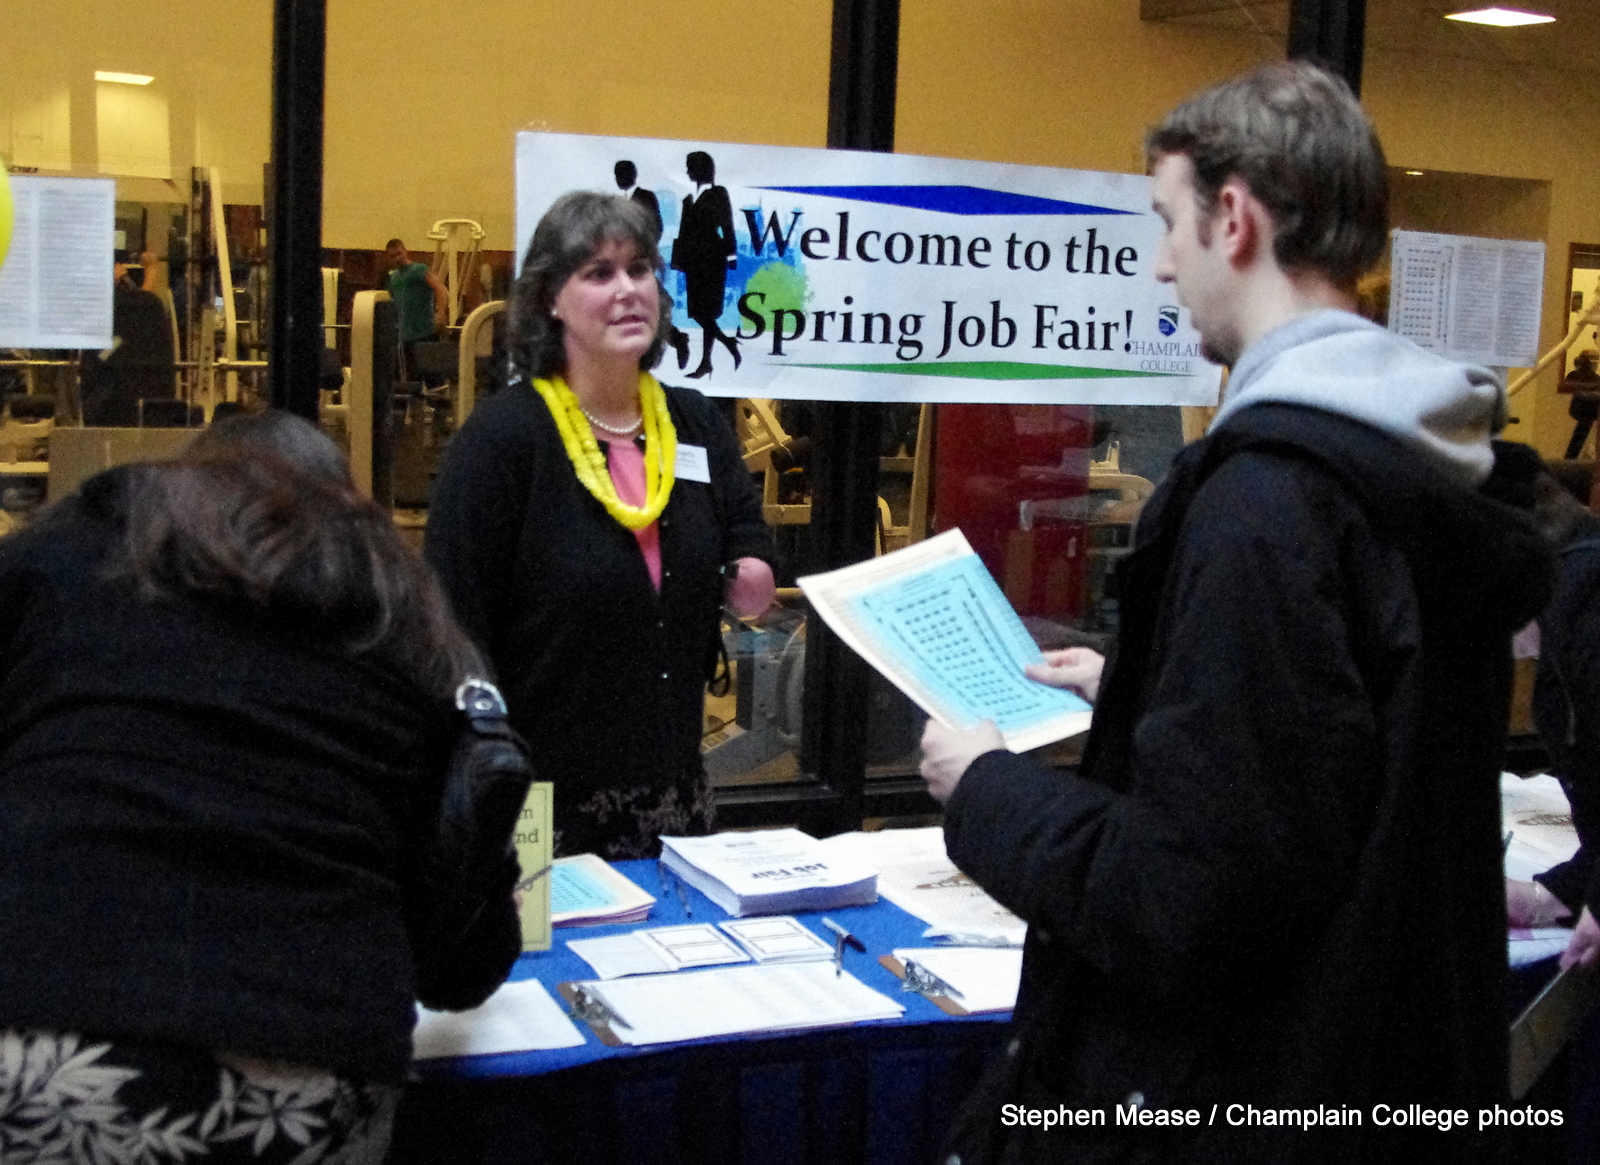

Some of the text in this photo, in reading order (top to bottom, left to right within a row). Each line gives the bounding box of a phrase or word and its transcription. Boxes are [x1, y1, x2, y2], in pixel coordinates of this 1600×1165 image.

[743, 208, 1139, 277] Welcome to the
[736, 291, 1135, 362] Spring Job Fair!
[1140, 359, 1192, 373] COLLEGE
